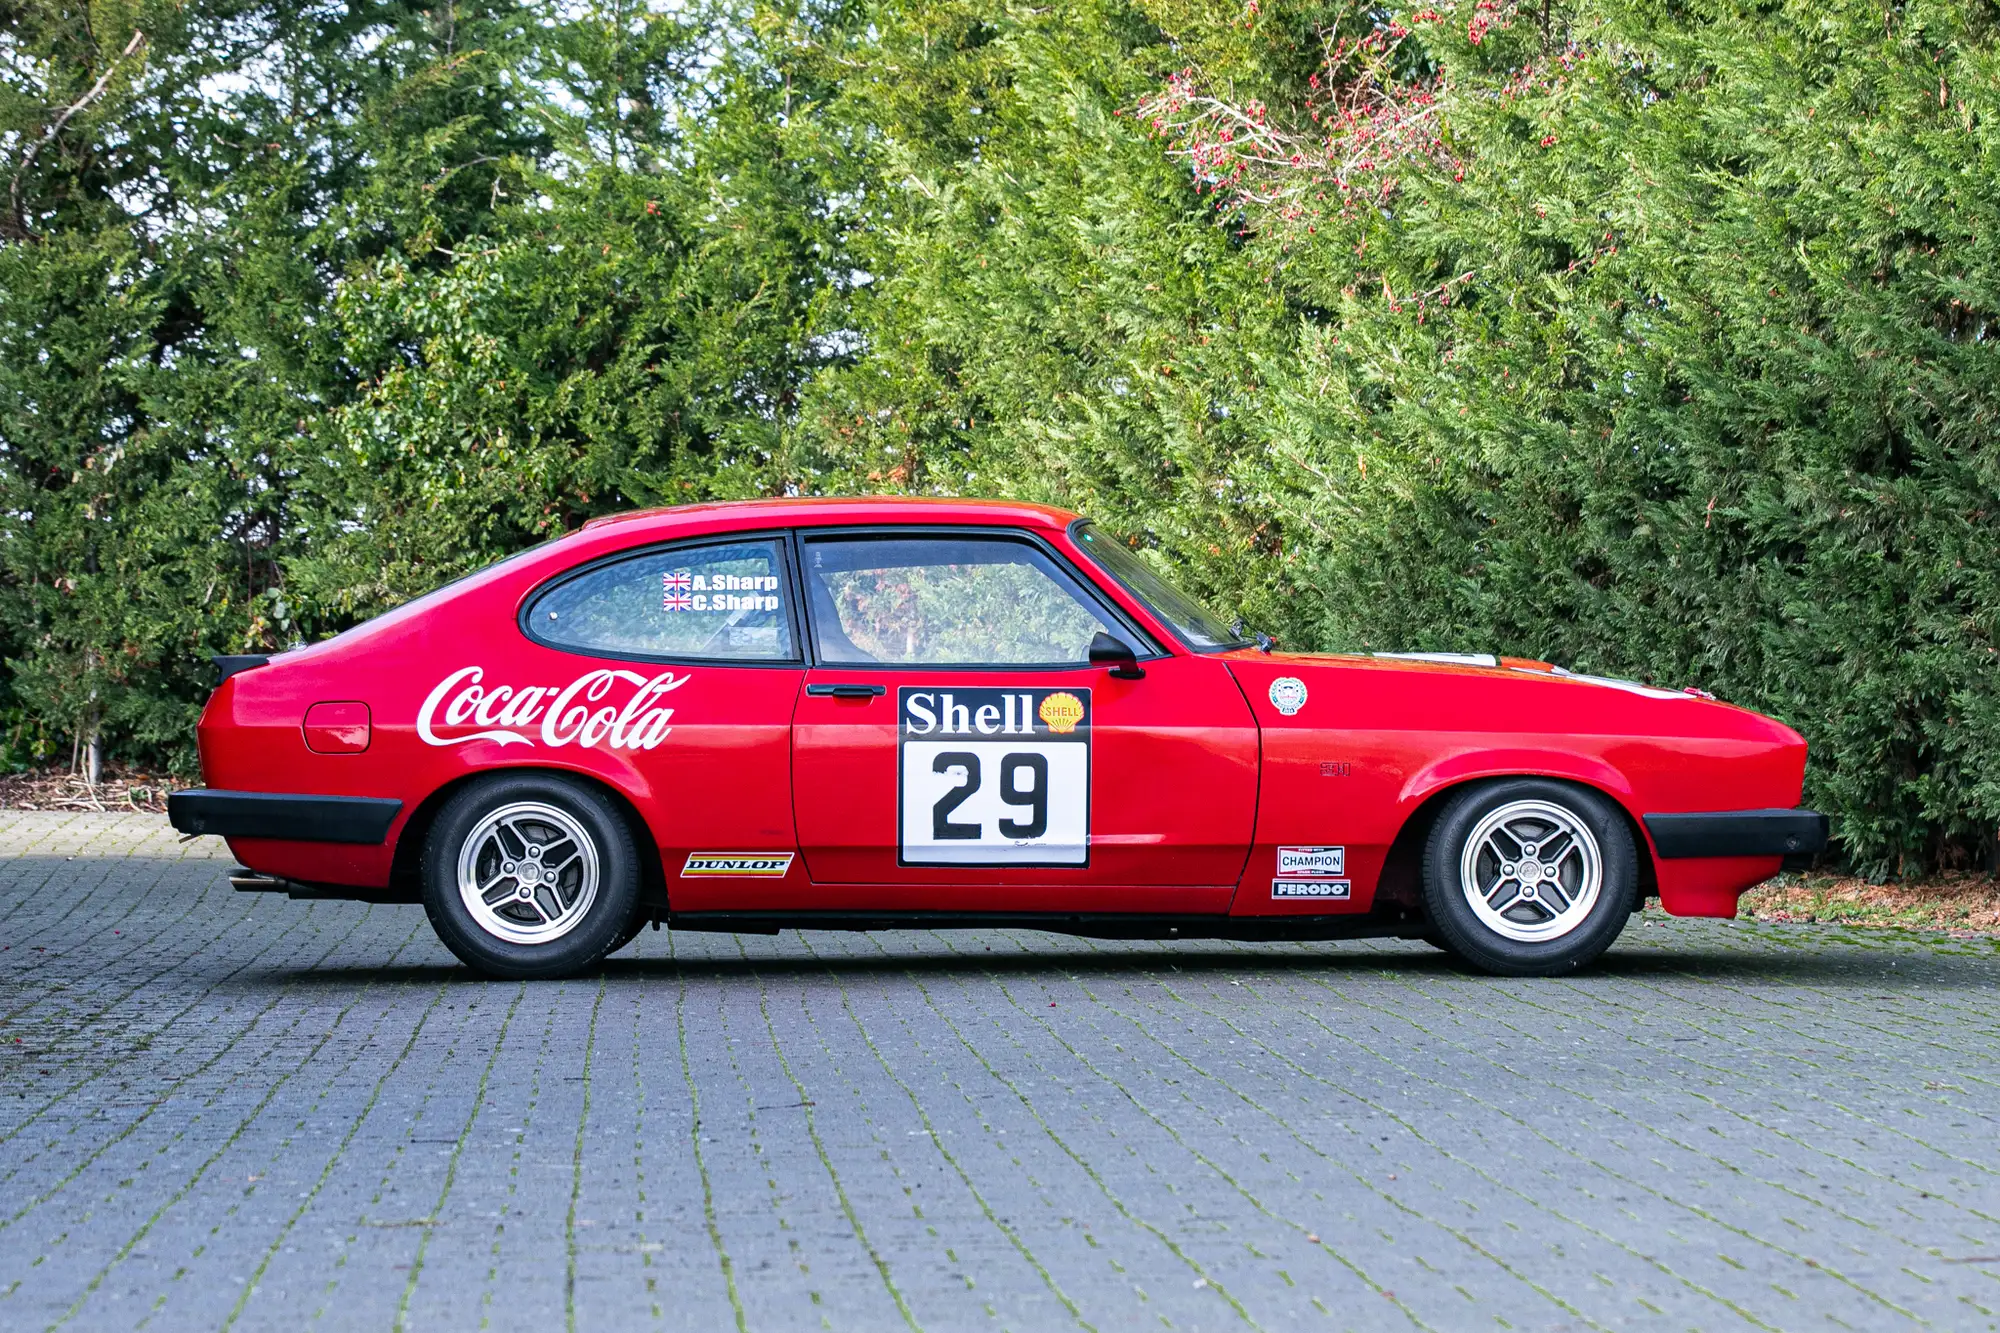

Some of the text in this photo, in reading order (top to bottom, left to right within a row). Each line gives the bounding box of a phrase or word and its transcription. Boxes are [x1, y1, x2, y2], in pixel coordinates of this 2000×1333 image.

[692, 574, 778, 592] A.Sharp
[692, 594, 779, 611] C.Sharp
[416, 665, 692, 750] Coca-Cola
[906, 692, 1036, 735] Shell
[1045, 706, 1079, 717] SHELL
[932, 751, 1049, 840] 29
[686, 860, 786, 869] DUNLOP
[1282, 856, 1340, 866] CHAMPION
[1277, 883, 1345, 895] FERODO
